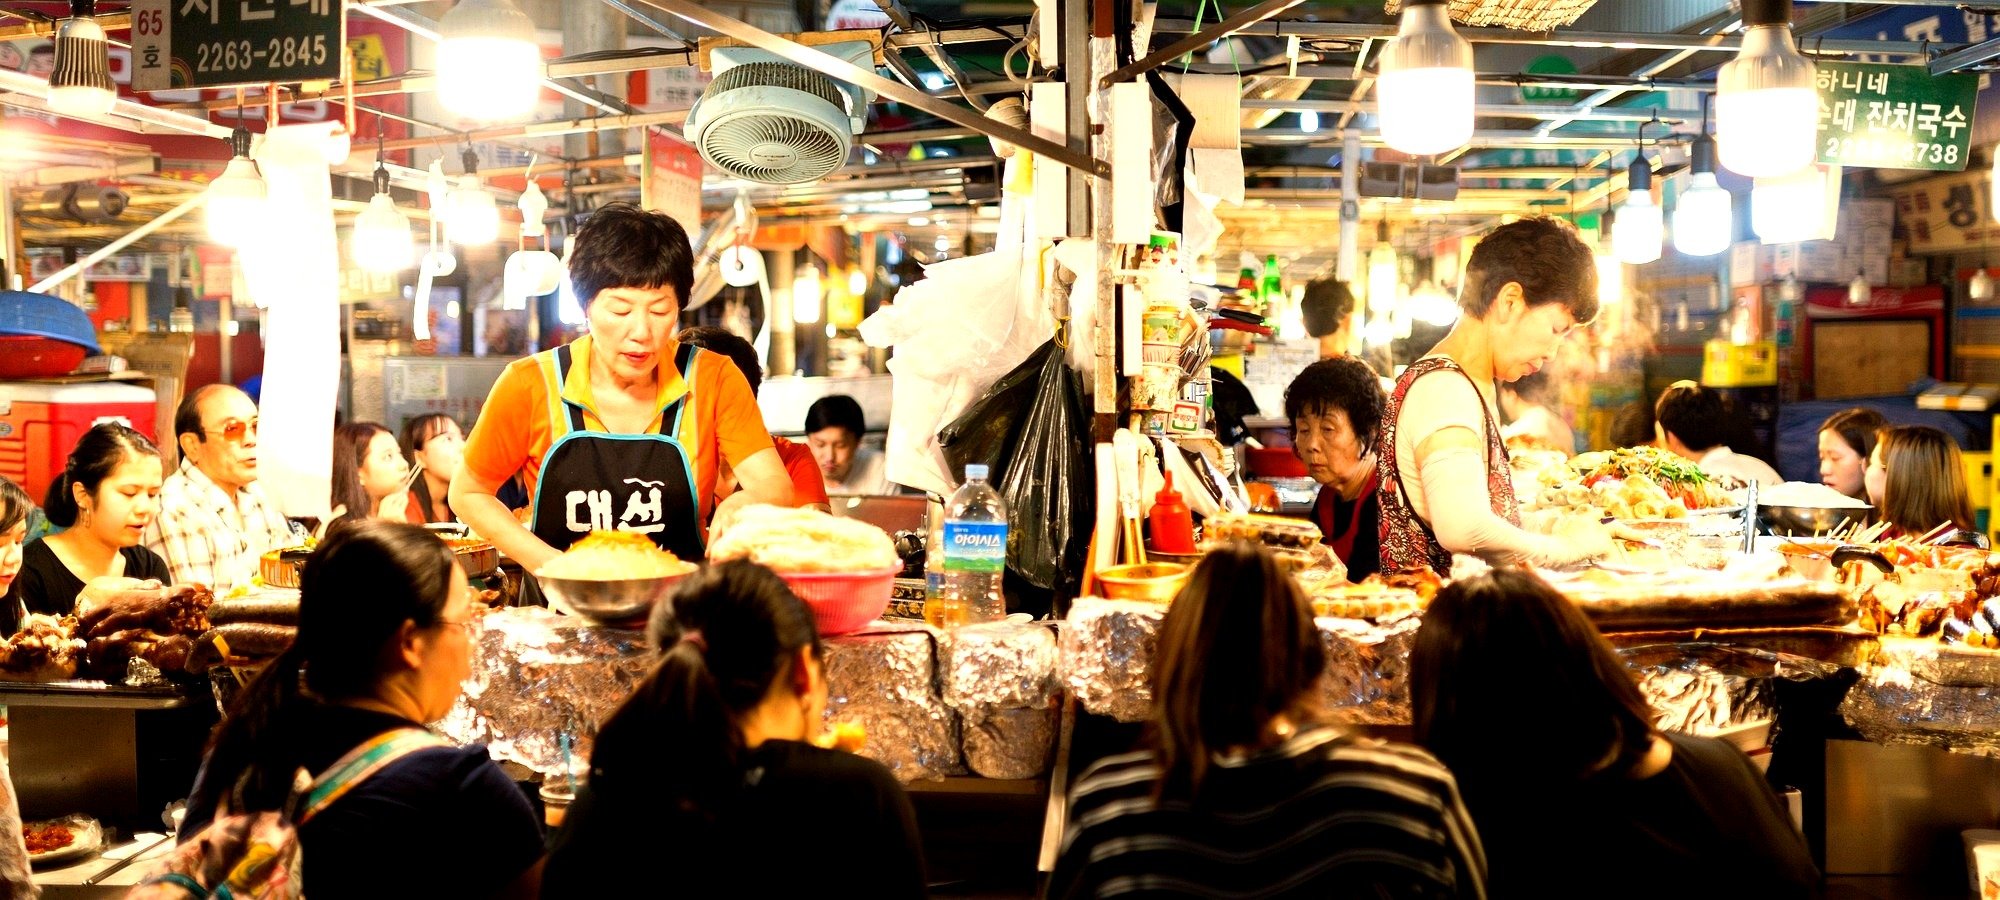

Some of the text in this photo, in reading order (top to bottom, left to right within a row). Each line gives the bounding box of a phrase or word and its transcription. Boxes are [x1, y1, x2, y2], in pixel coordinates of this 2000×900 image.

[138, 9, 163, 36] 65
[141, 45, 162, 69] 호
[197, 34, 327, 72] 2263-2845
[1866, 100, 1967, 138] 잔치국수
[955, 534, 1001, 547] 아이시스
